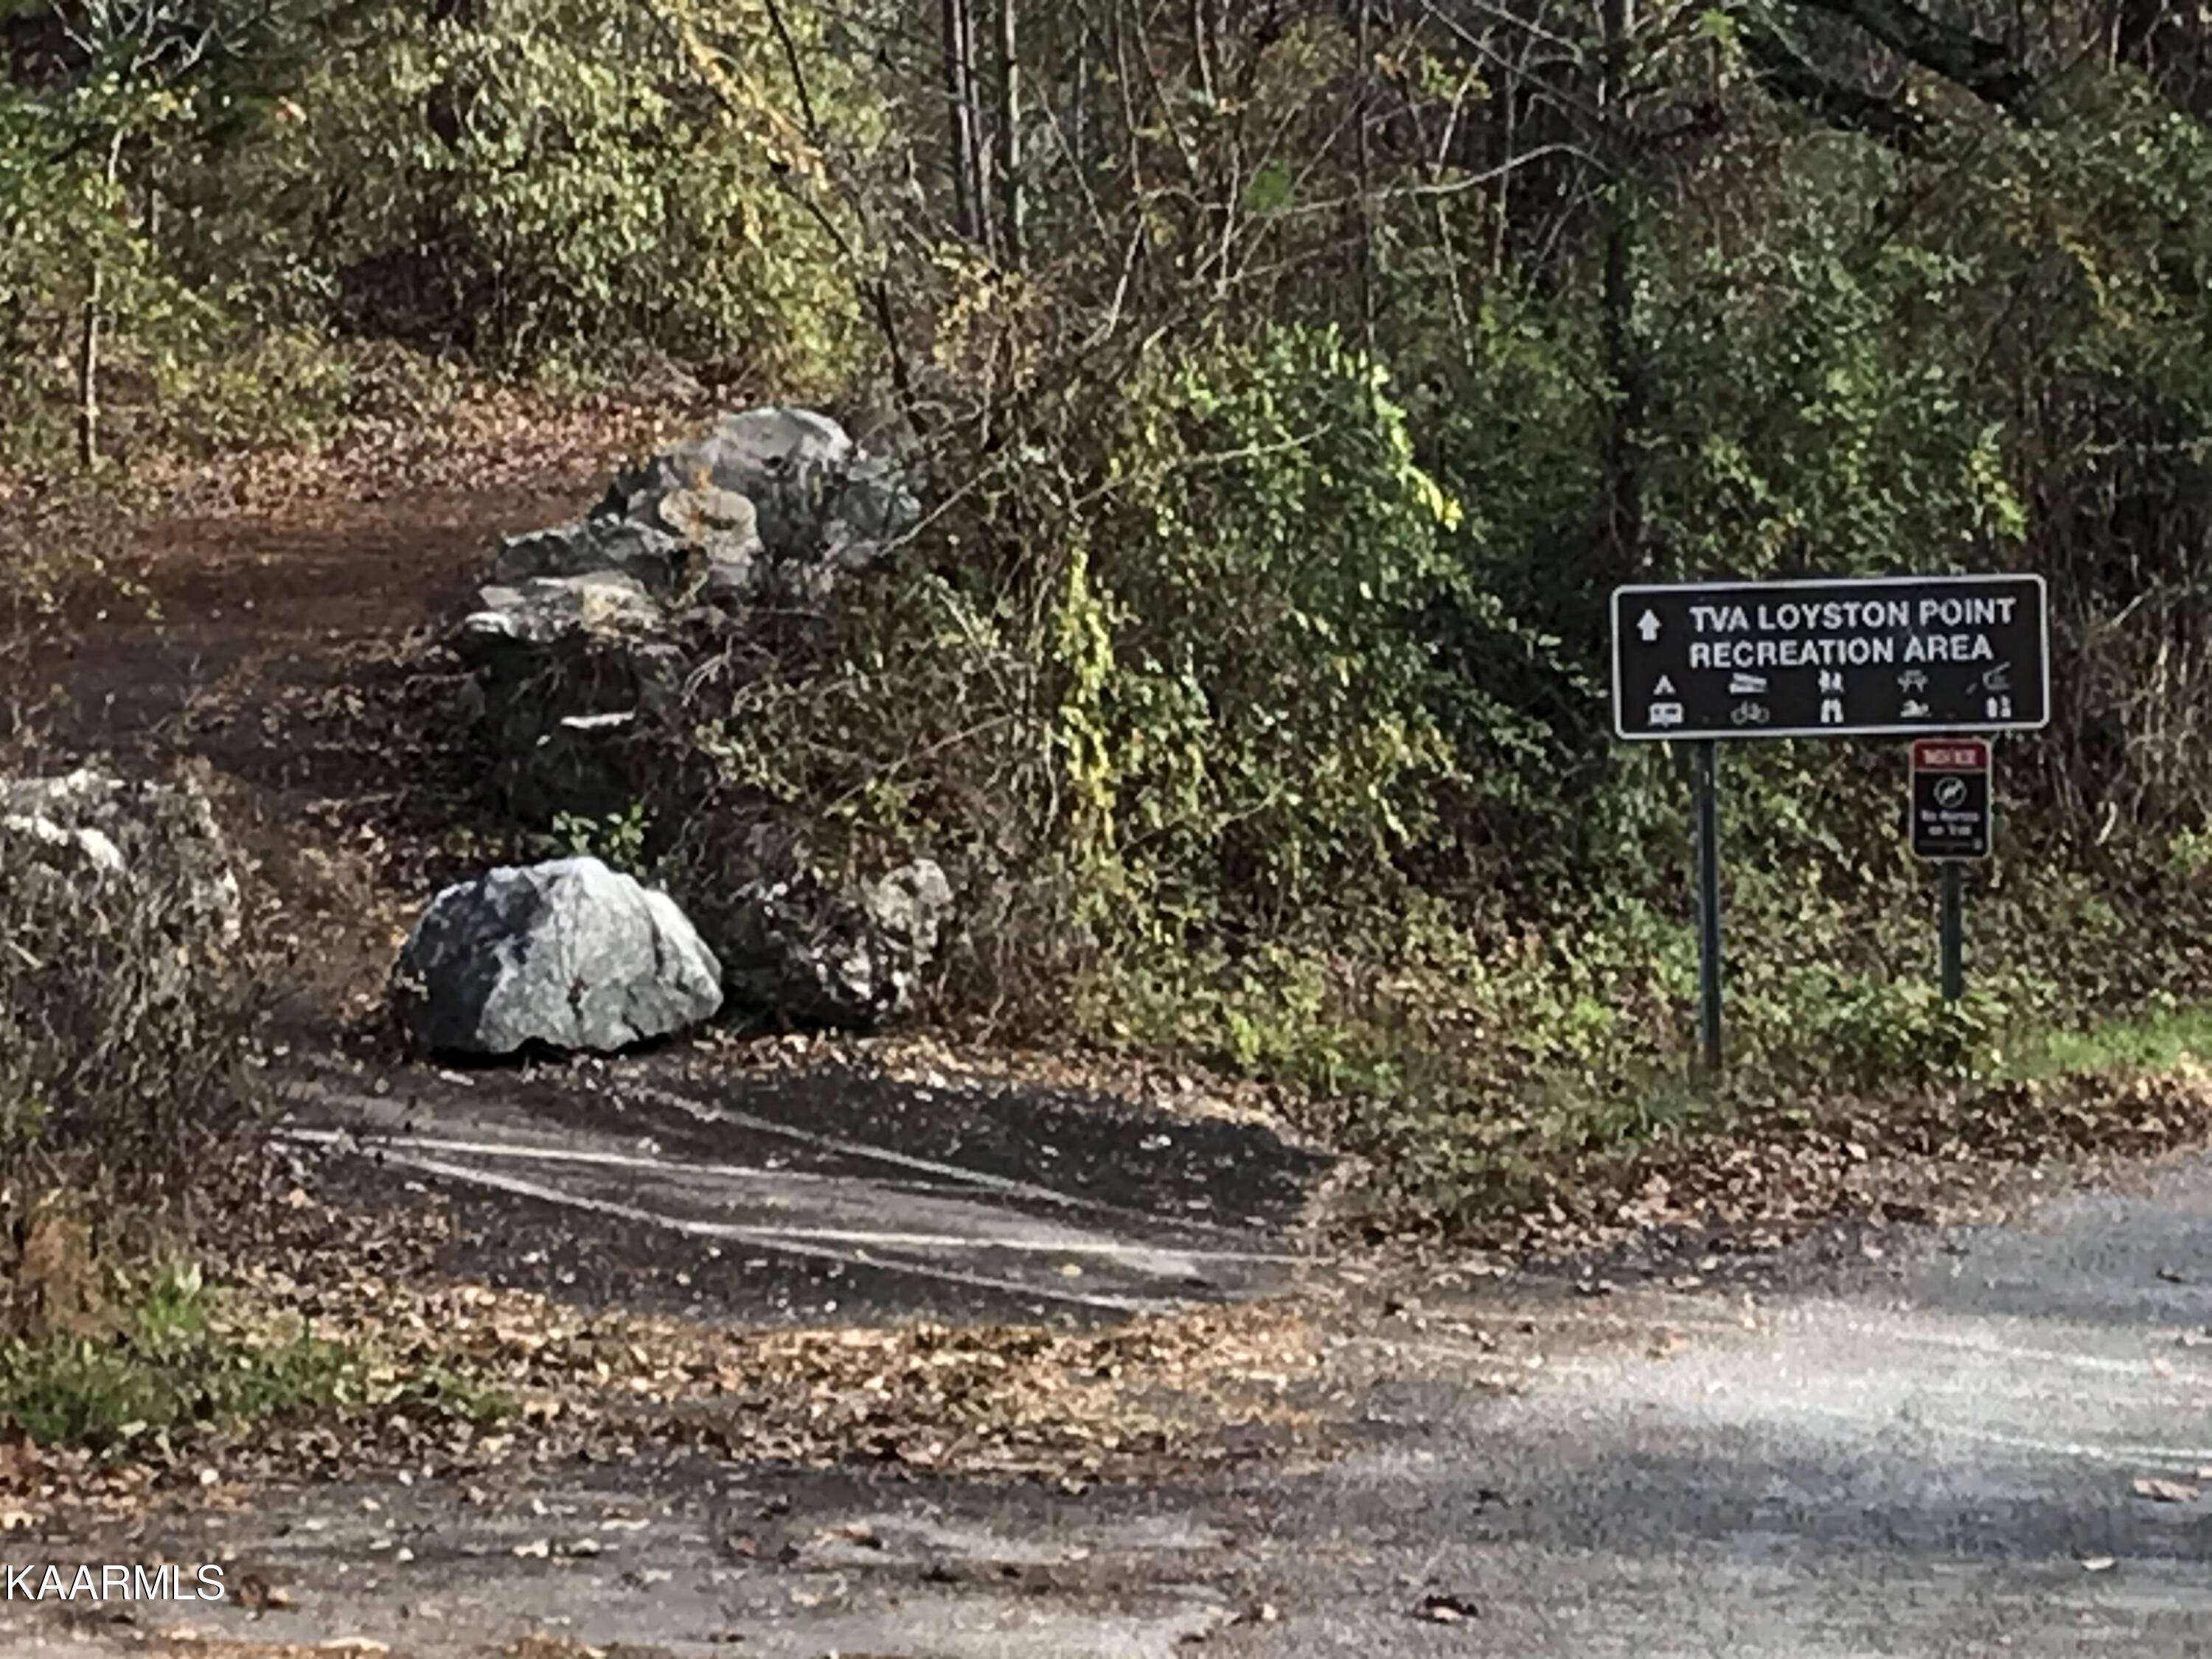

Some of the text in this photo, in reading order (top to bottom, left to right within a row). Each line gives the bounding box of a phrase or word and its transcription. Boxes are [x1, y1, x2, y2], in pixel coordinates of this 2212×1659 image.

[1689, 597, 2016, 633] TVA LOYSTON POINT
[1689, 634, 1993, 669] RECREATION AREA
